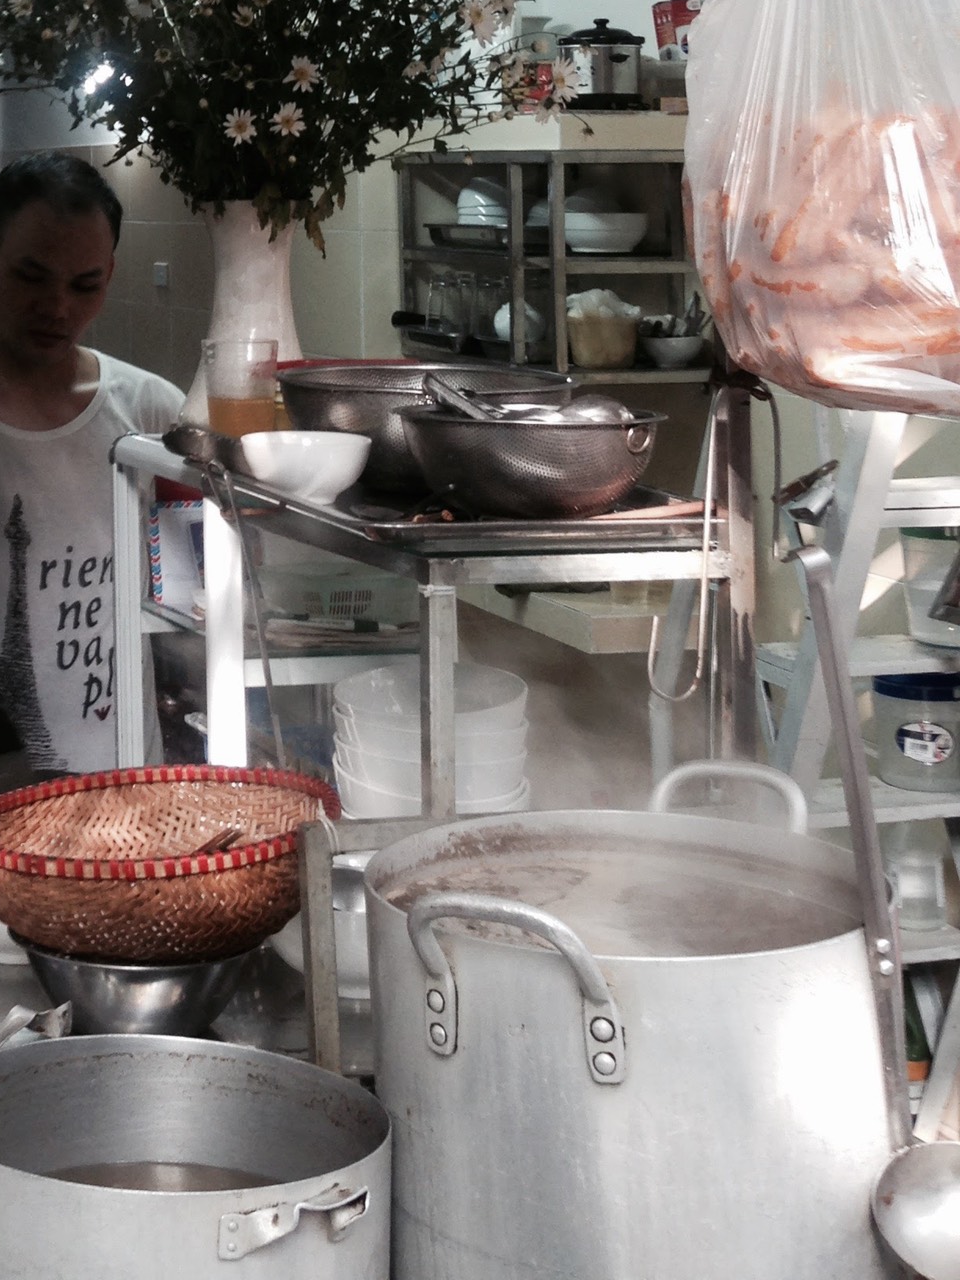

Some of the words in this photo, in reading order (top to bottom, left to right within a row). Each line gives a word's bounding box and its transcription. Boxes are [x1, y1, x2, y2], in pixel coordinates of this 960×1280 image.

[38, 545, 114, 591] rien
[56, 596, 102, 631] ne
[56, 635, 103, 670] va
[82, 646, 114, 719] pl
